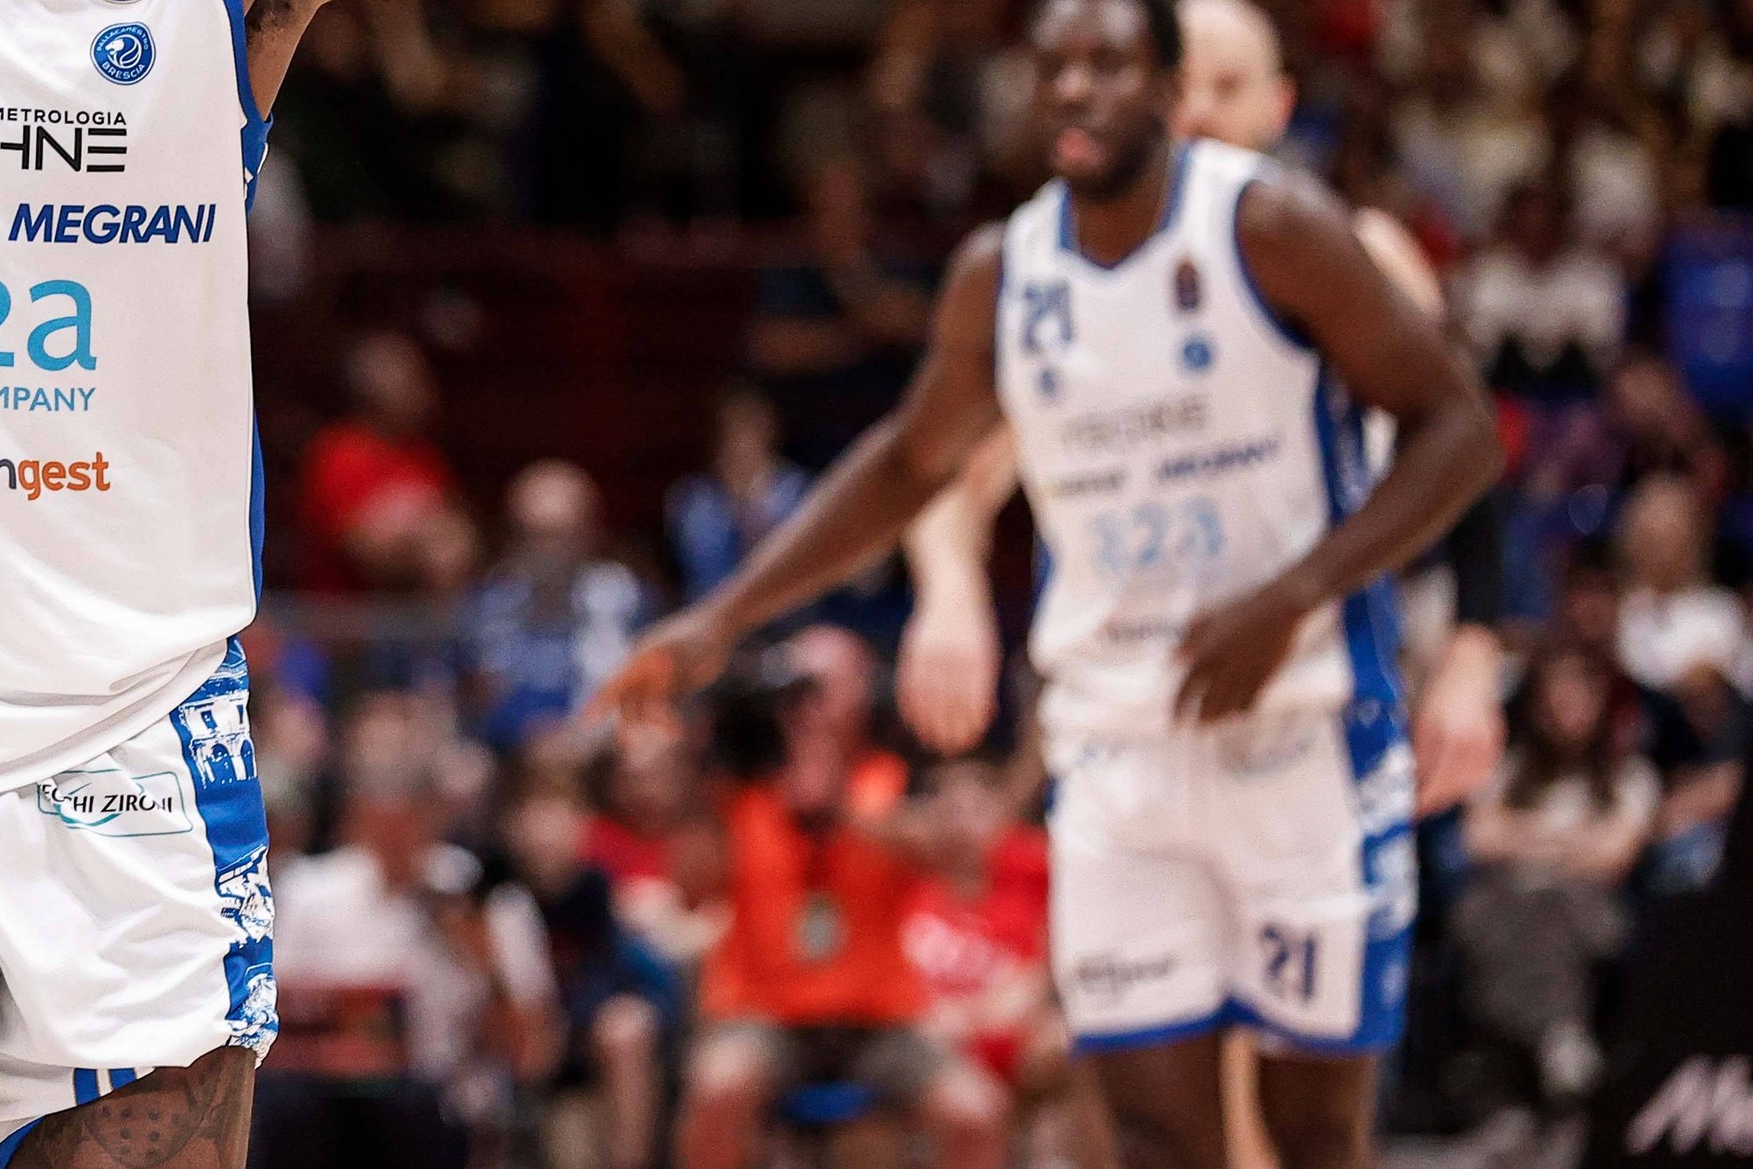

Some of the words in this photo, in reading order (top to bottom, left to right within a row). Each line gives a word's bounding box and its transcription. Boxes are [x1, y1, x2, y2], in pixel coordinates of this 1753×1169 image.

[102, 61, 145, 80] BRESCIA
[8, 203, 216, 244] MEGRANI
[38, 784, 94, 813] ECHI
